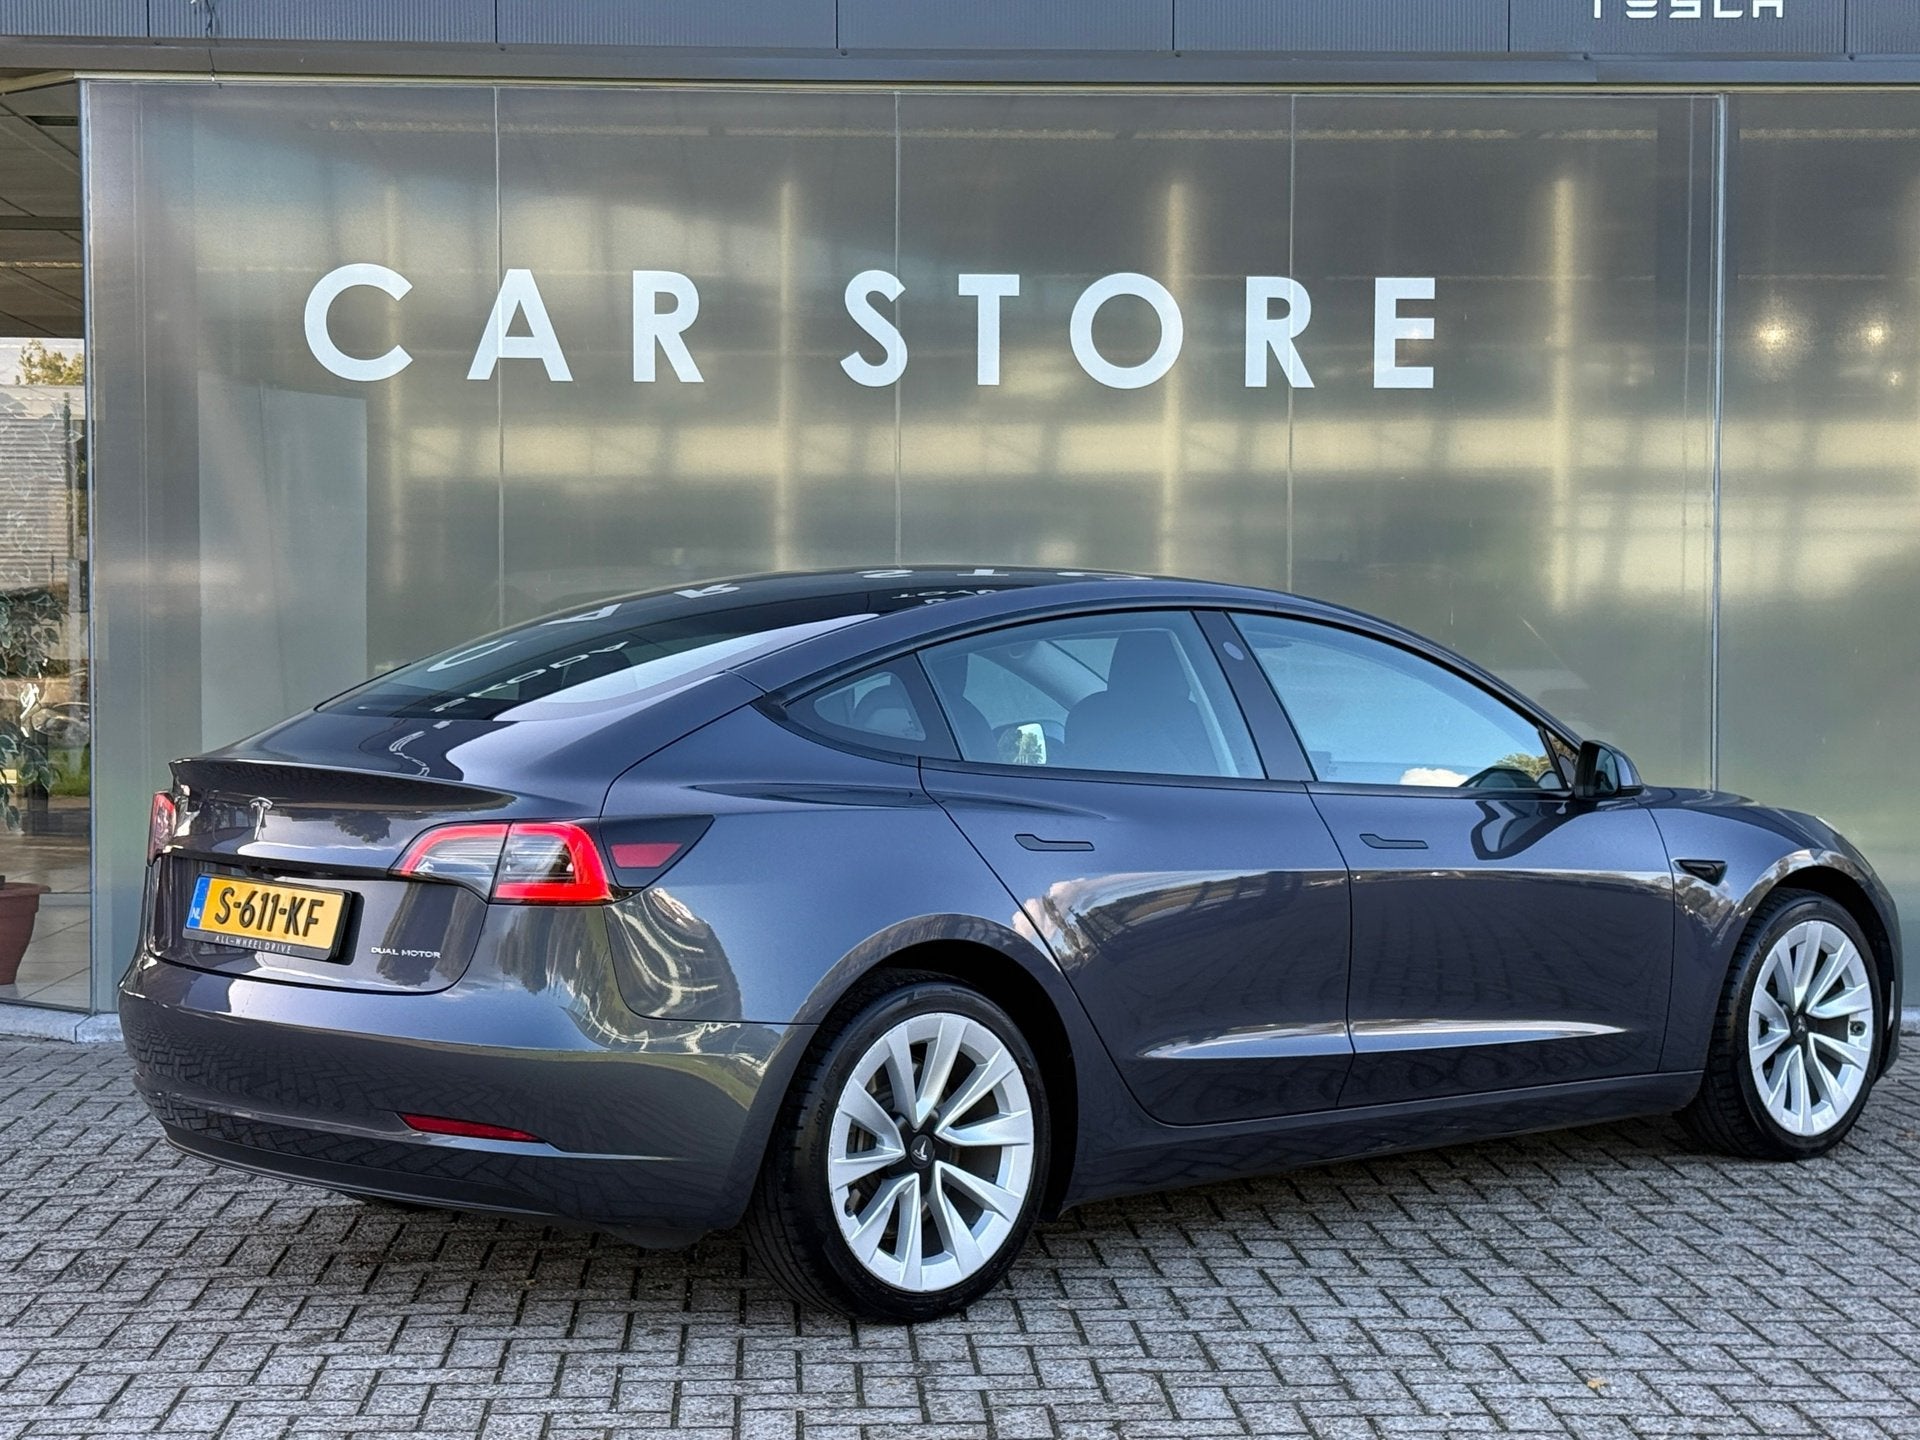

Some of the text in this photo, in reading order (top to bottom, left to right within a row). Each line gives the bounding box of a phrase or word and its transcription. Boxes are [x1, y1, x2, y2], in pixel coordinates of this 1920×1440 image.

[304, 263, 1436, 390] CAR STORE
[214, 887, 325, 938] S-611-KF
[214, 935, 292, 954] ALL-WHEEL DRIVE
[370, 946, 441, 959] DUAL MOTOR
